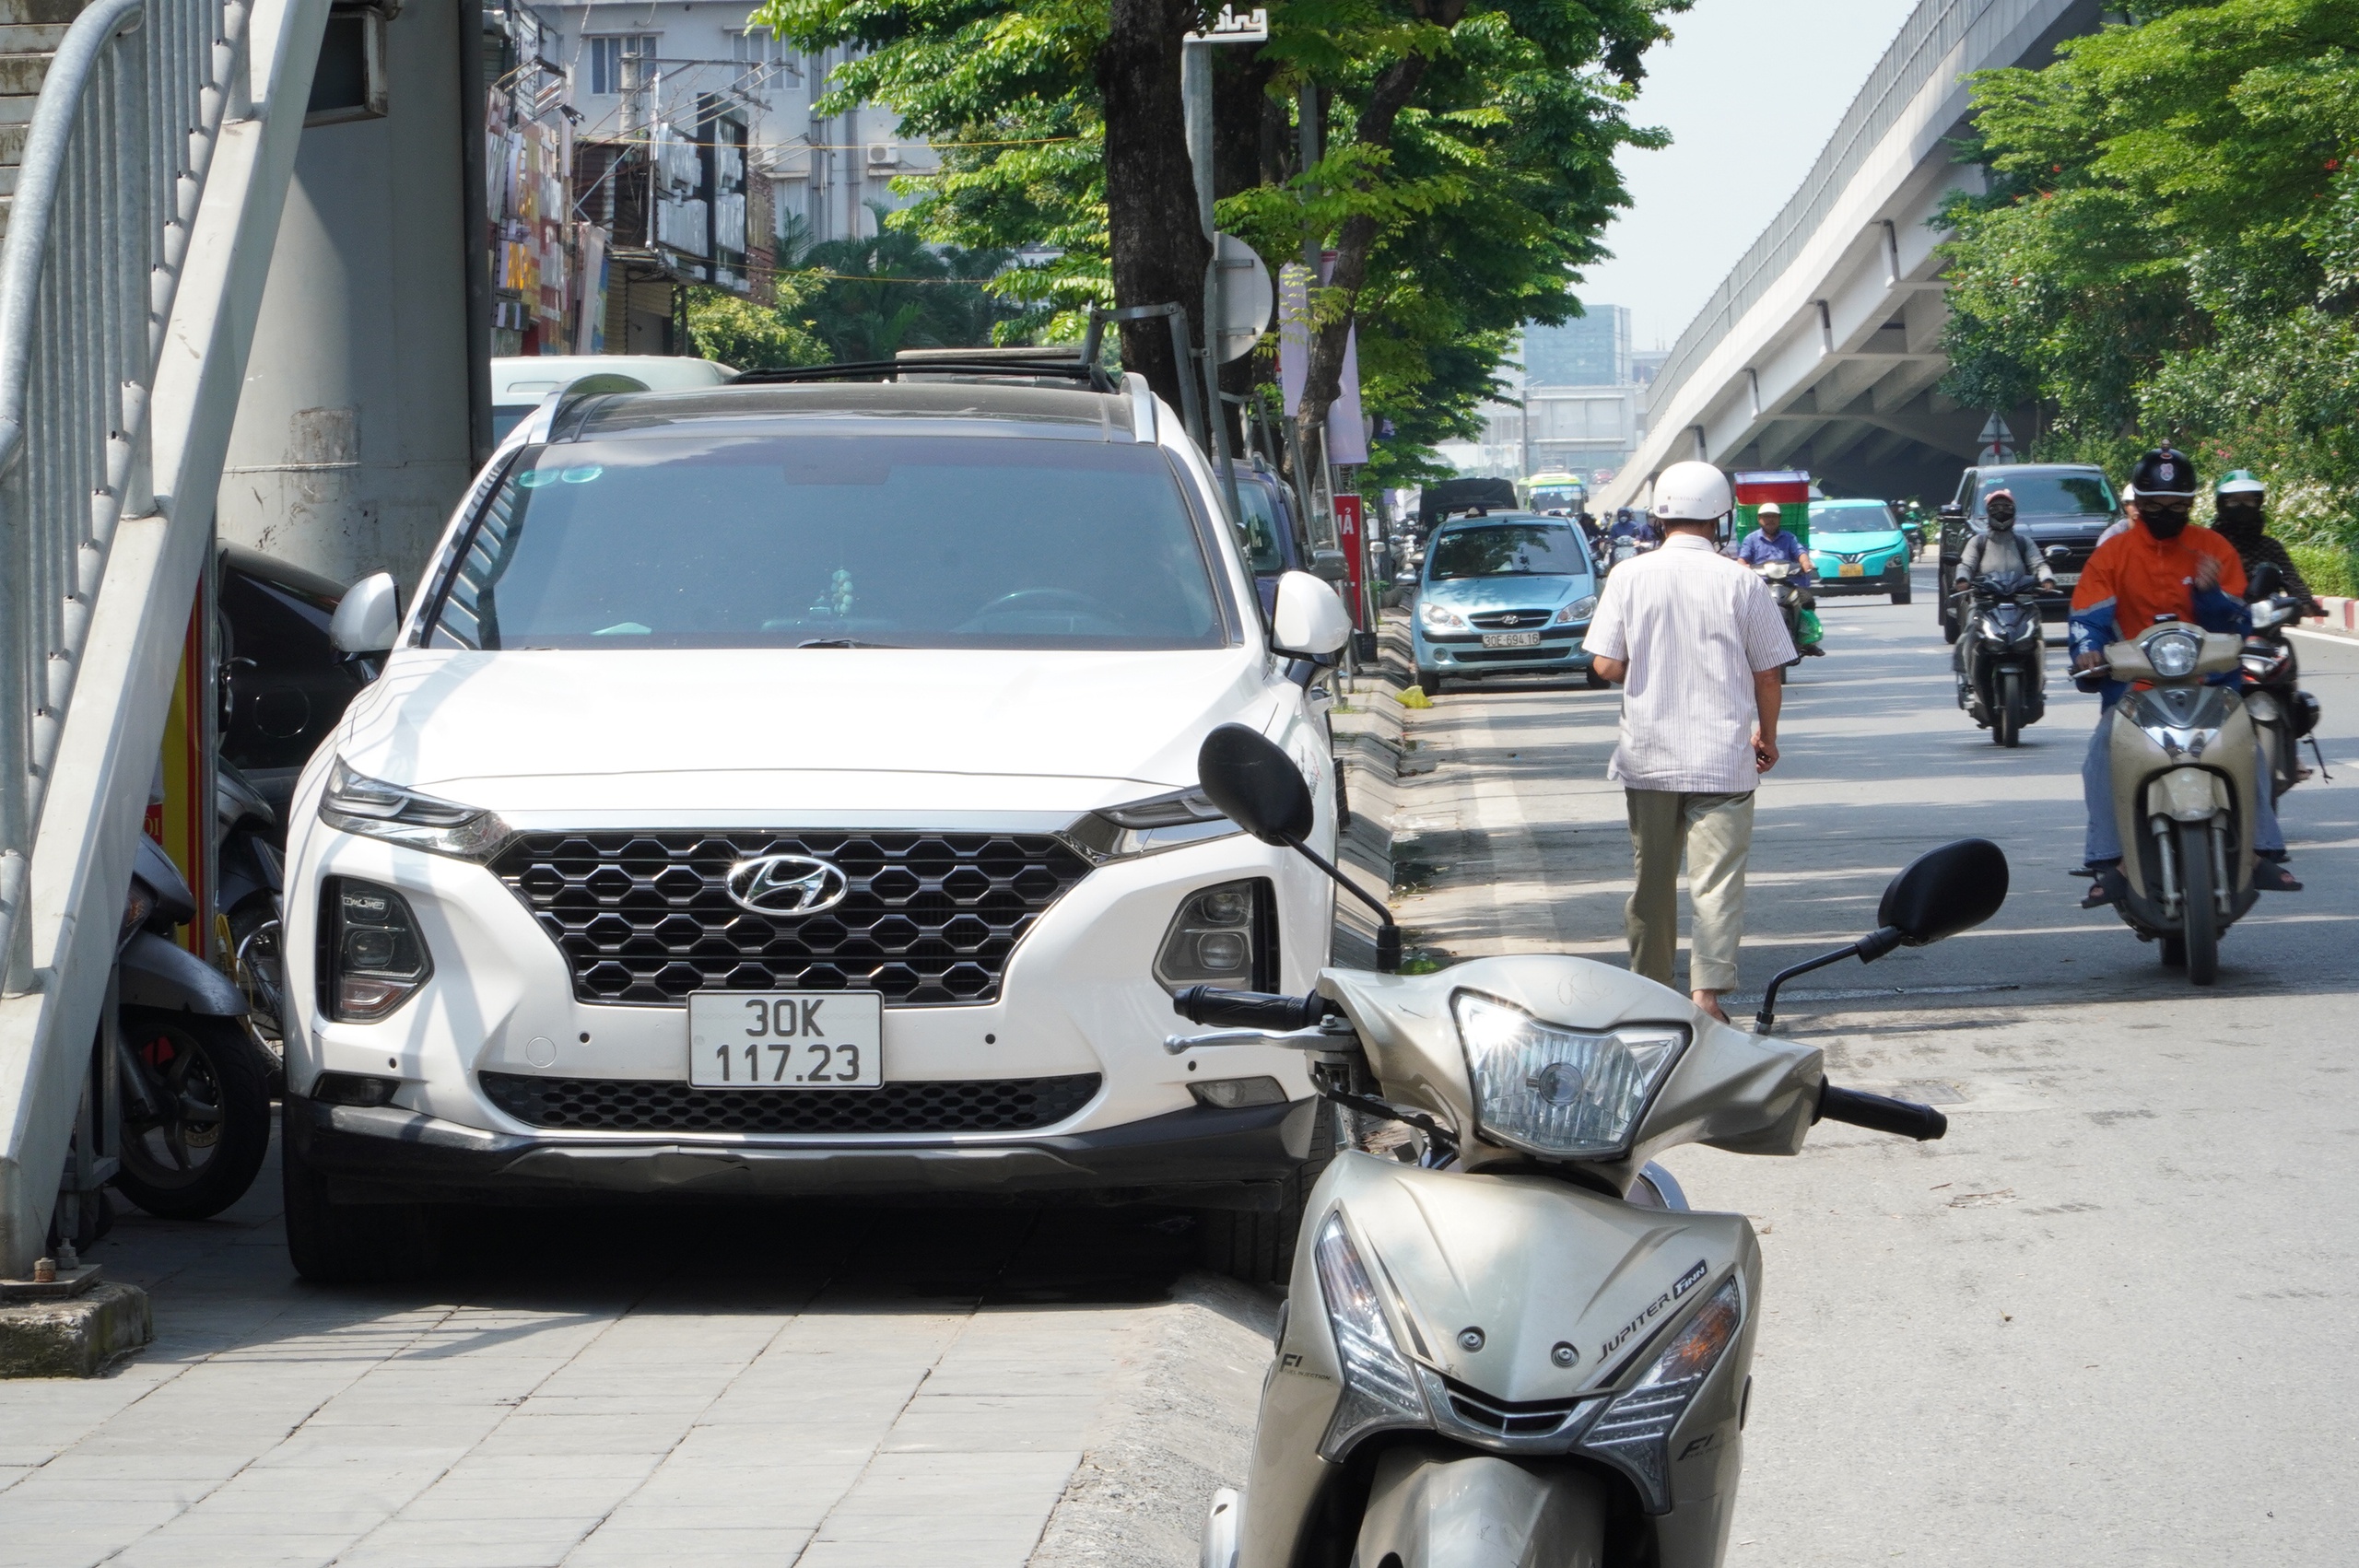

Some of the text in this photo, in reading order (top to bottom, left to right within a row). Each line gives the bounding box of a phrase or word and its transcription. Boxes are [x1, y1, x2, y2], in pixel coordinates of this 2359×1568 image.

[745, 999, 825, 1037] 30K
[716, 1044, 860, 1082] 117.23
[1597, 1293, 1671, 1364] JUPITER
[1279, 1353, 1303, 1372] FI
[1677, 1433, 1715, 1461] FI
